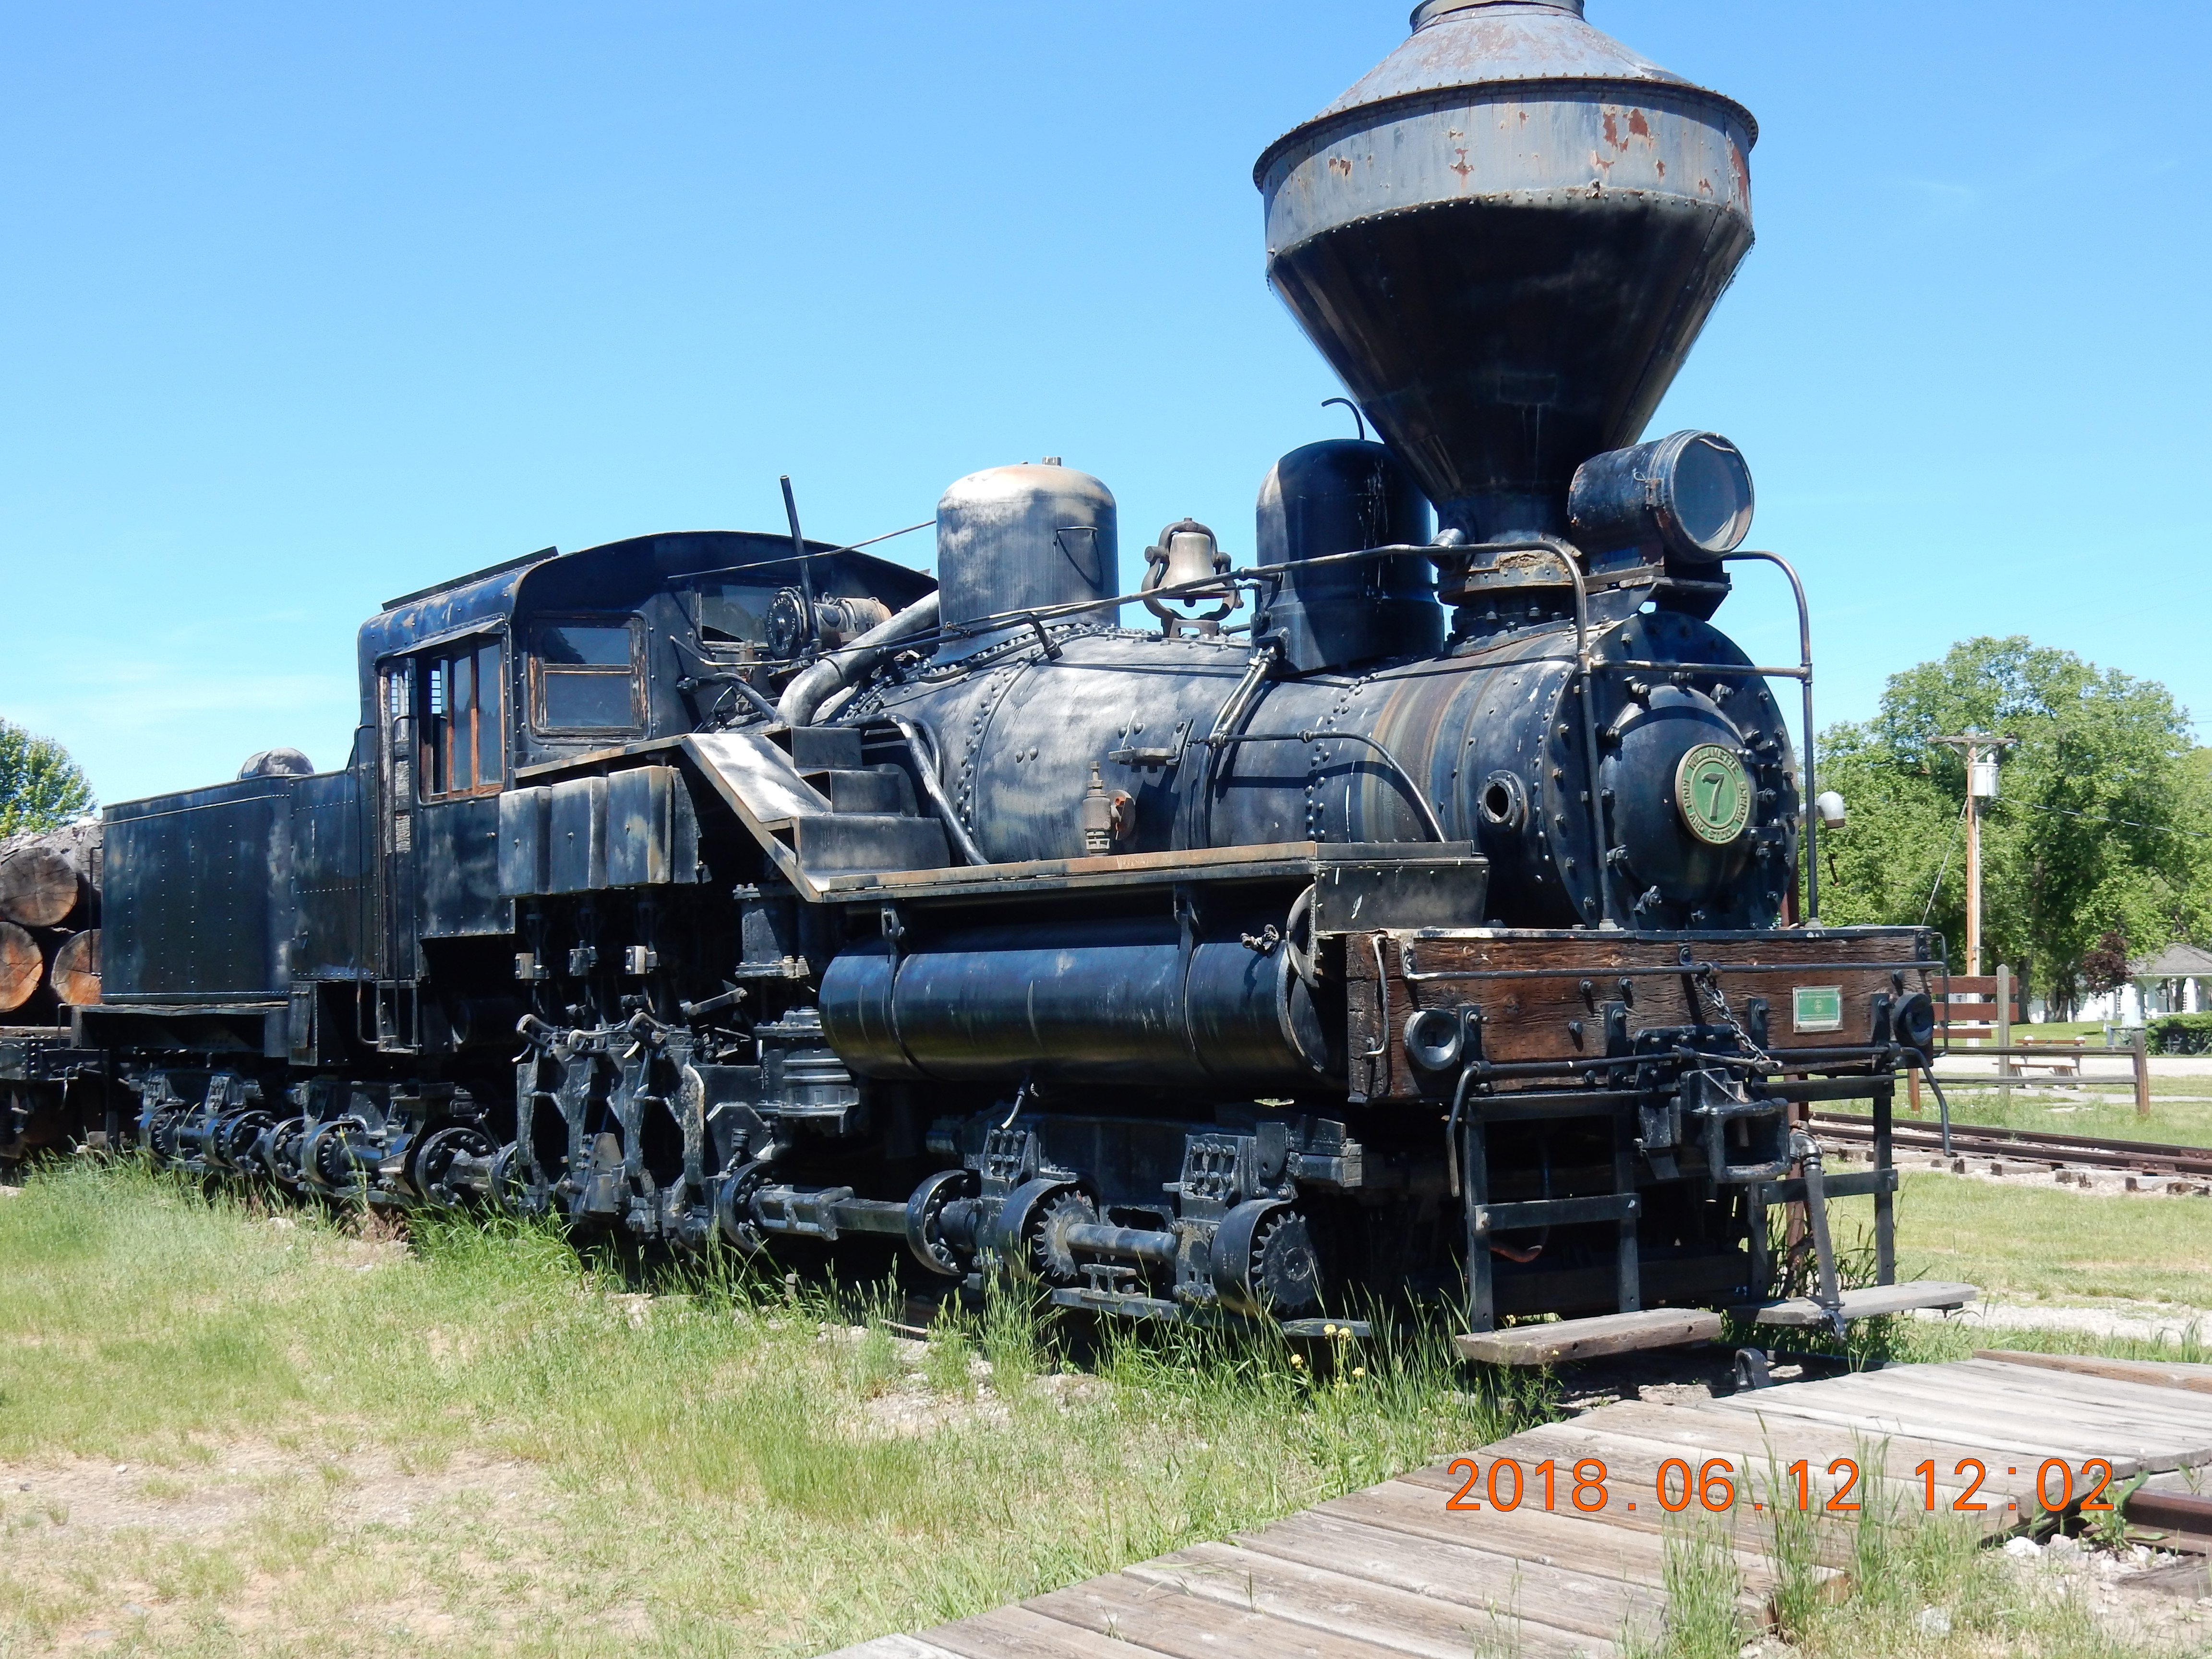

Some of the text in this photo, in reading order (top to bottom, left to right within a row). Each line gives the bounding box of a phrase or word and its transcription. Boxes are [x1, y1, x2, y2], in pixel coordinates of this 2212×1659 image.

[1686, 746, 1740, 775] WILLAMETTE
[1682, 779, 1747, 841] IRON AND STEEL WORKS
[1701, 771, 1725, 821] 7
